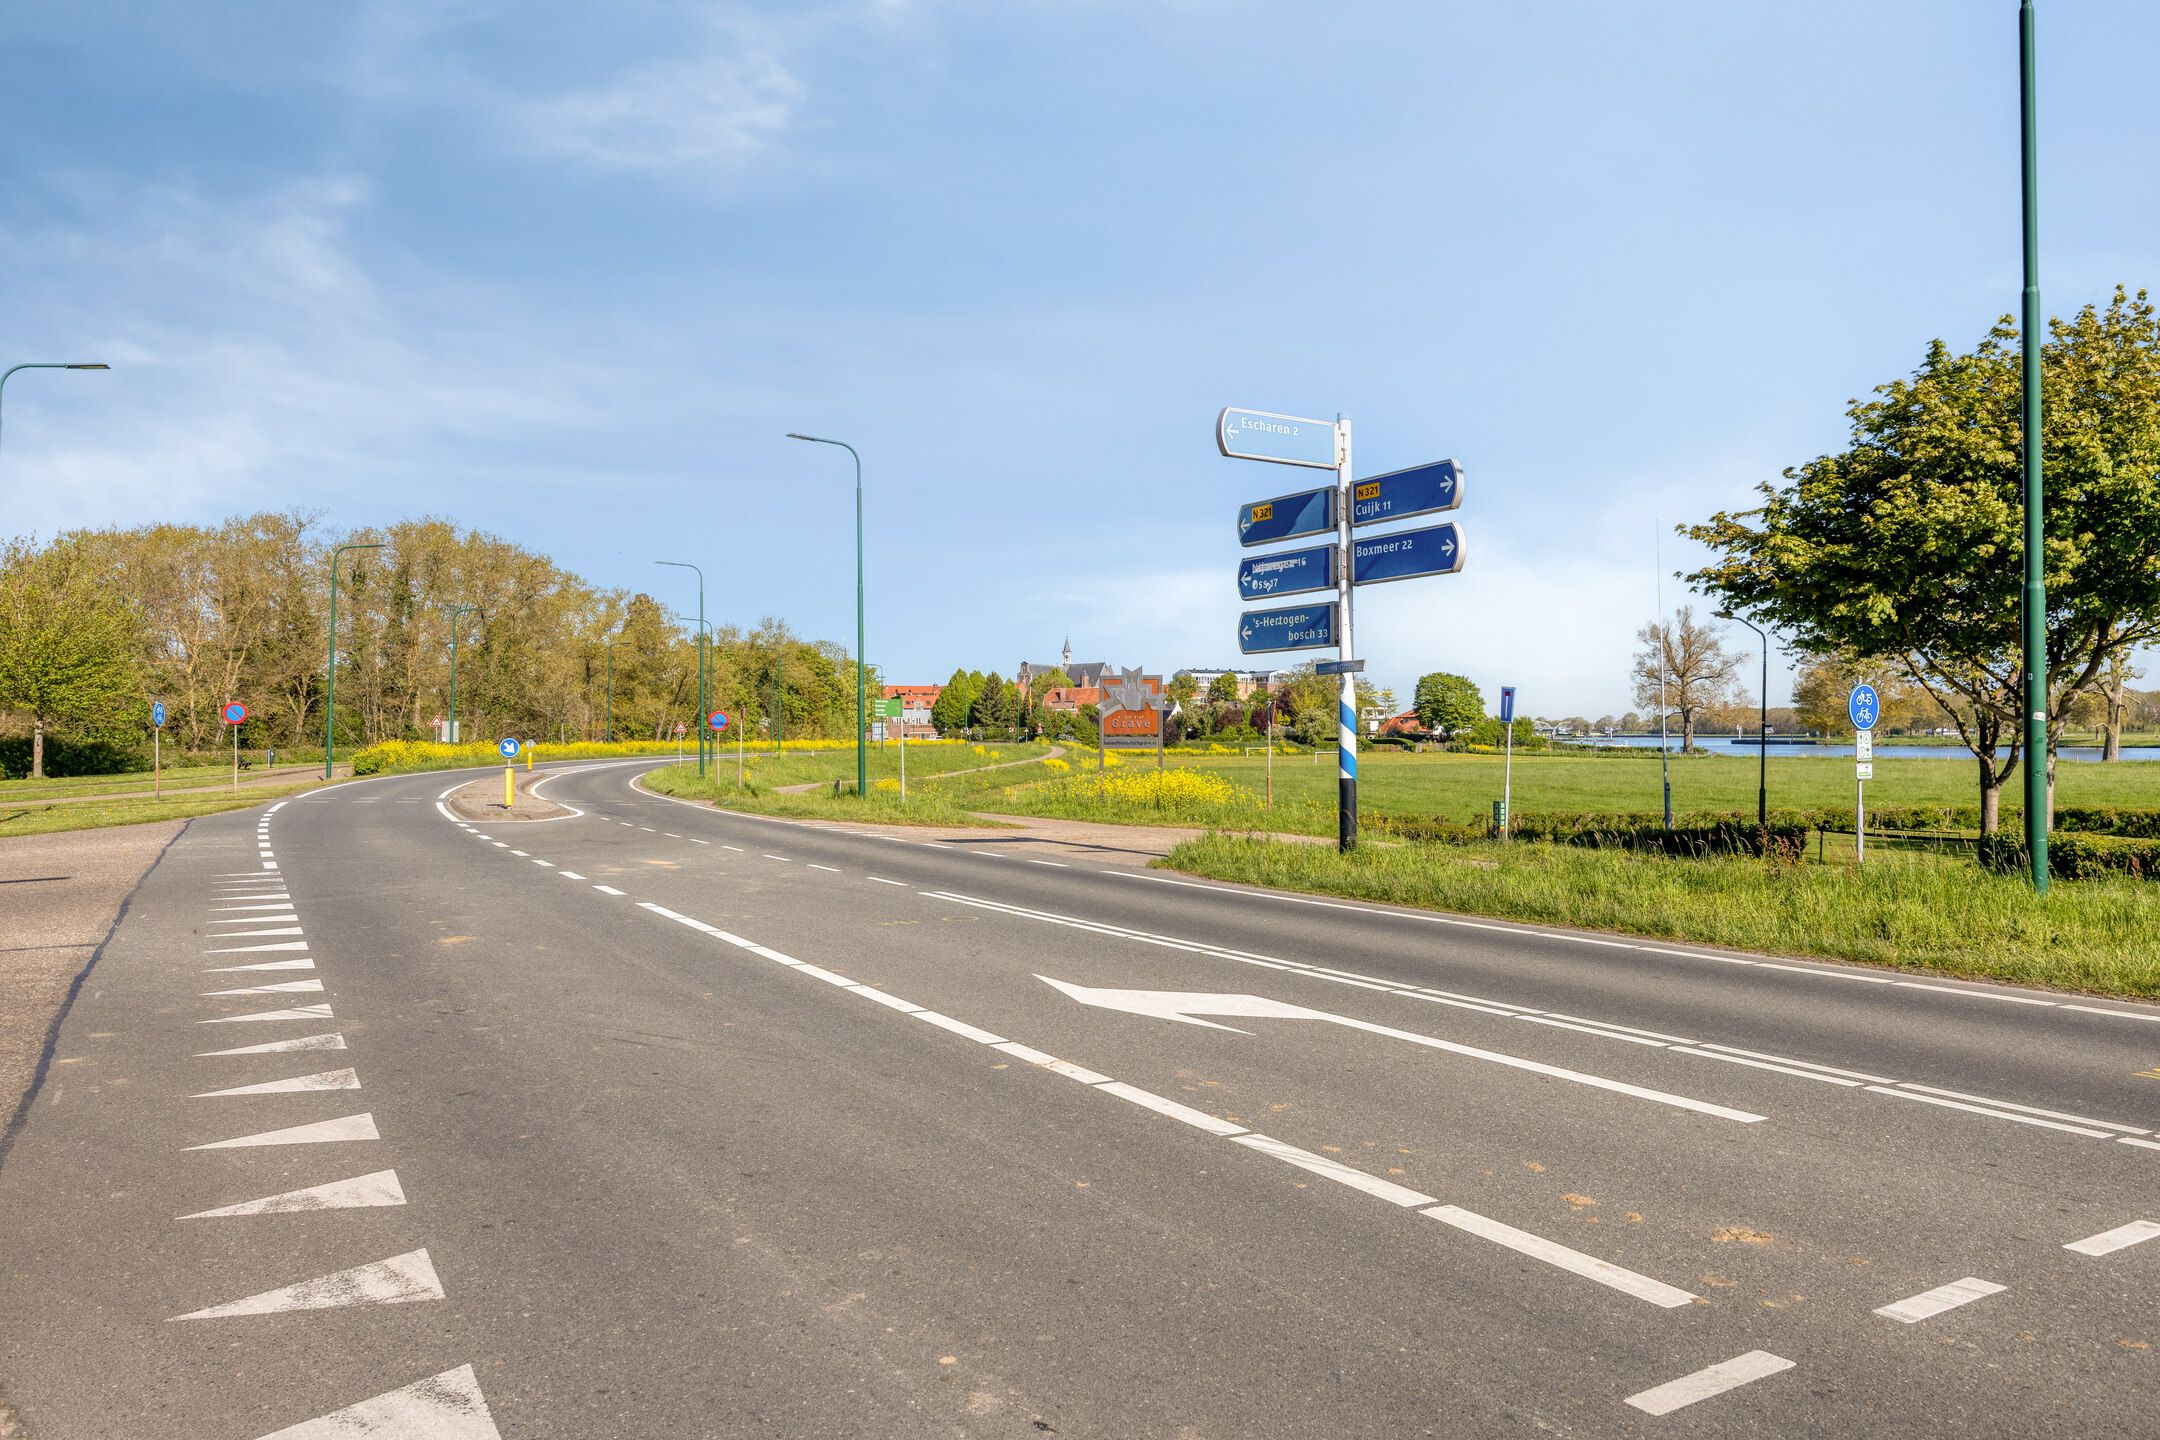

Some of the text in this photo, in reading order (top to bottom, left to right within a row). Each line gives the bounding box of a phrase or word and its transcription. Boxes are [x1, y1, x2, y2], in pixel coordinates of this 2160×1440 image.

[1241, 417, 1299, 436] Escharen 2
[1355, 500, 1391, 516] Cuijk 11
[1356, 540, 1413, 558] Boxmeer 22
[1253, 615, 1310, 628] 's-Hertogen-
[1288, 629, 1328, 641] bosch 33
[1111, 718, 1151, 729] Grave
